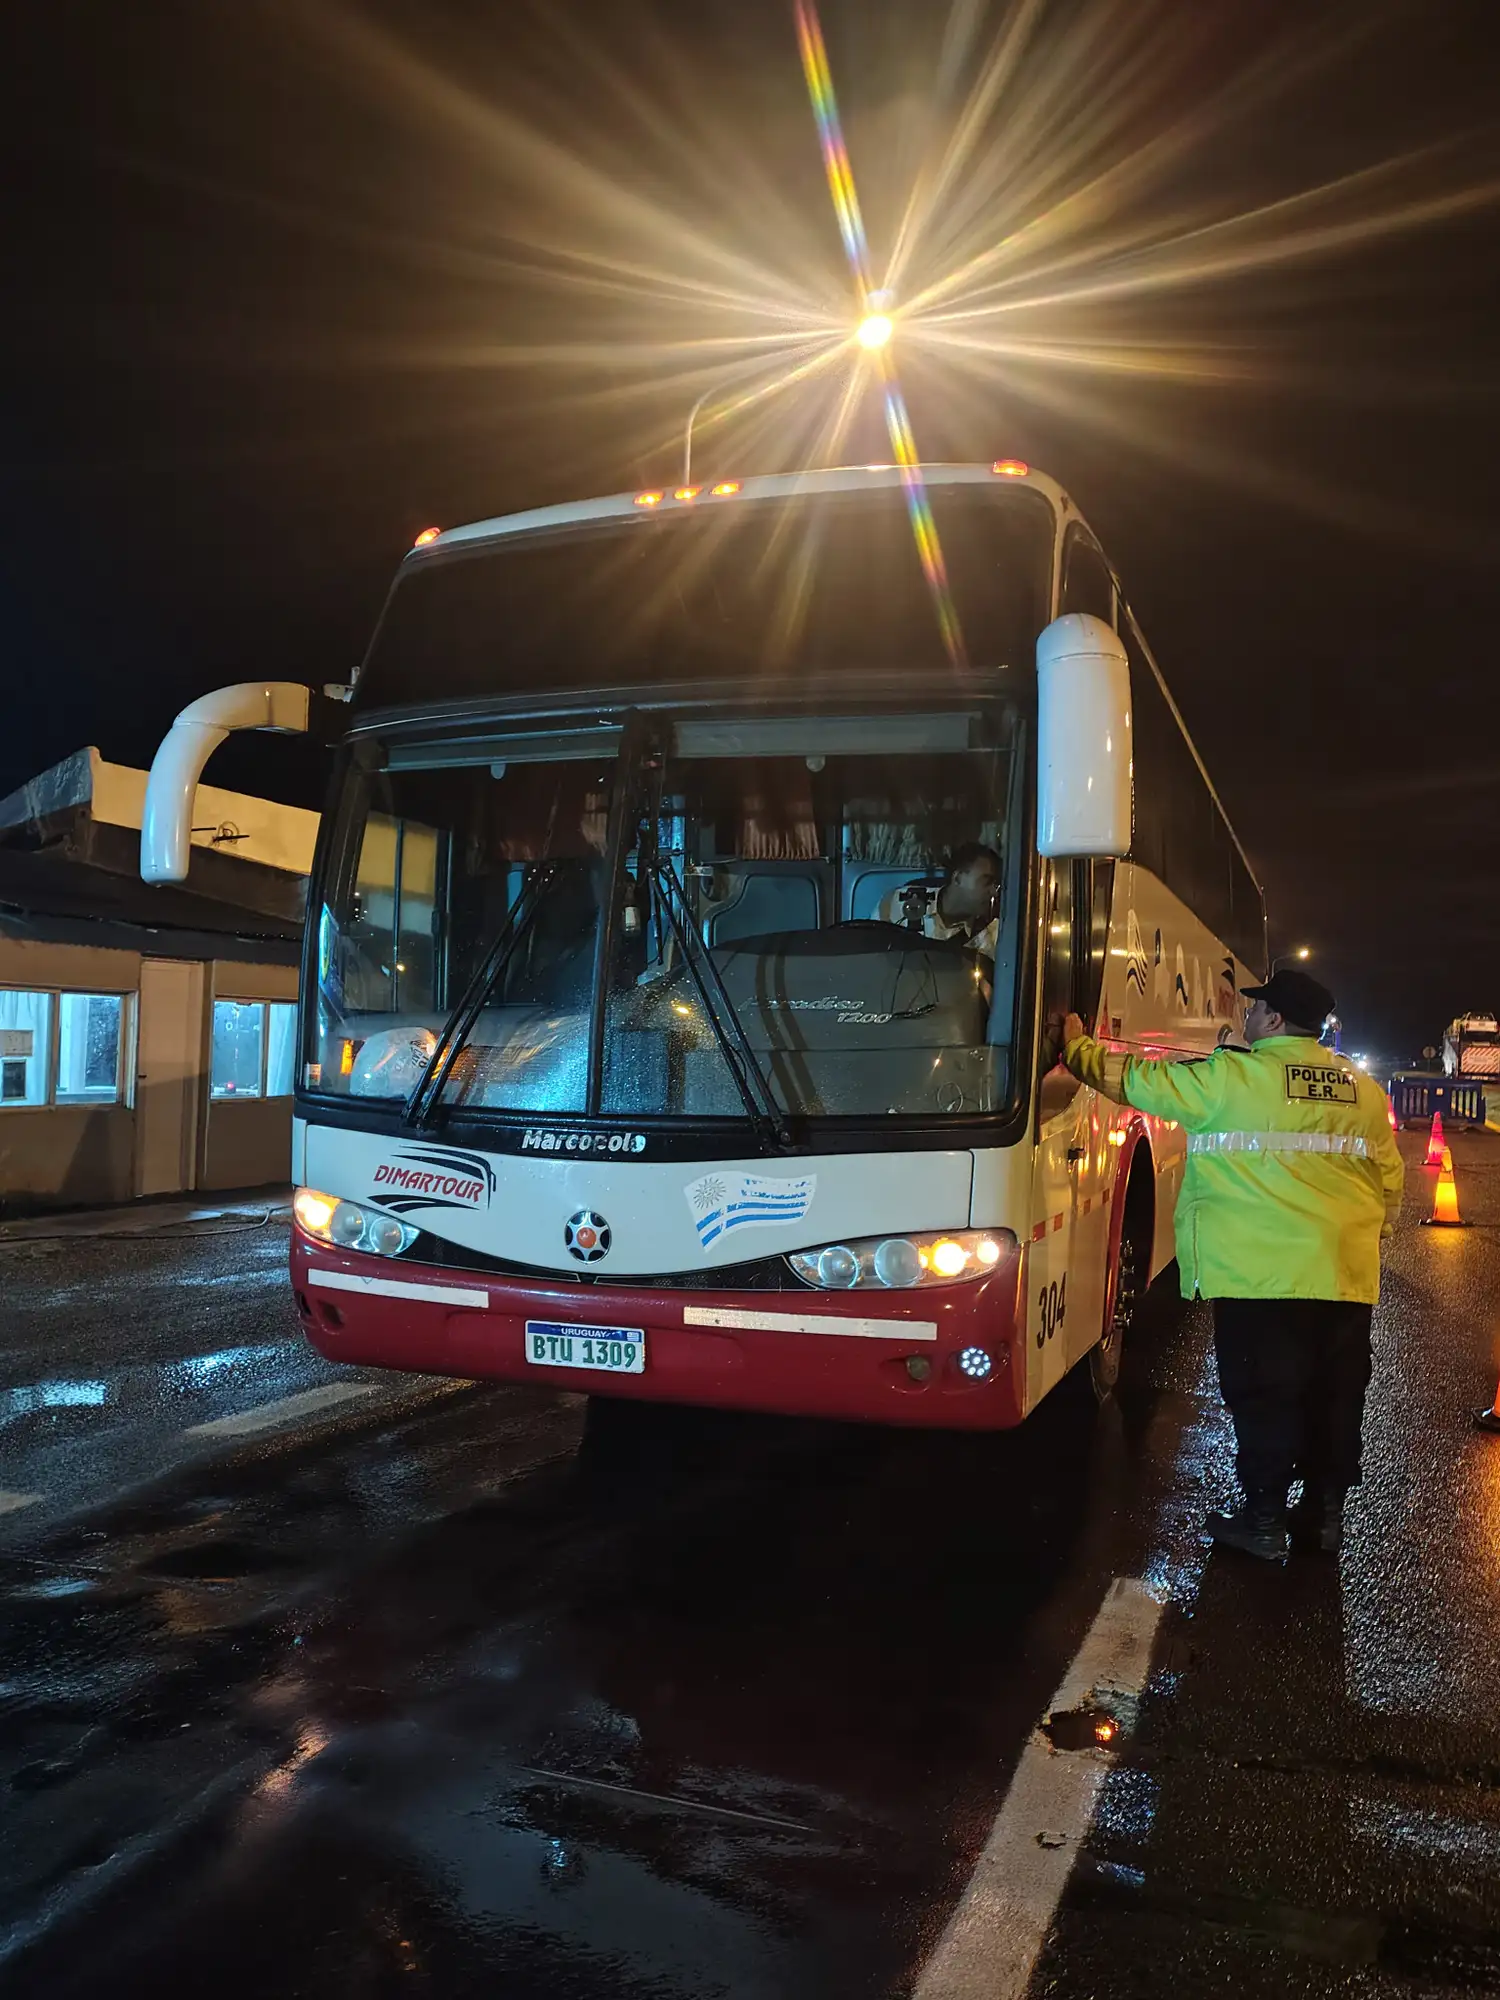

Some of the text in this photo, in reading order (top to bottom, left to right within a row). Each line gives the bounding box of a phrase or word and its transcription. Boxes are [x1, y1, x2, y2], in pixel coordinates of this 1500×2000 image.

[837, 1013, 892, 1024] 1200
[1308, 1084, 1338, 1099] E.R.
[521, 1129, 647, 1154] Marcopolo
[373, 1164, 485, 1202] DIMARTOUR
[1036, 1271, 1067, 1350] 304
[560, 1327, 608, 1338] URUGUAY
[533, 1335, 636, 1368] BTU 1309
